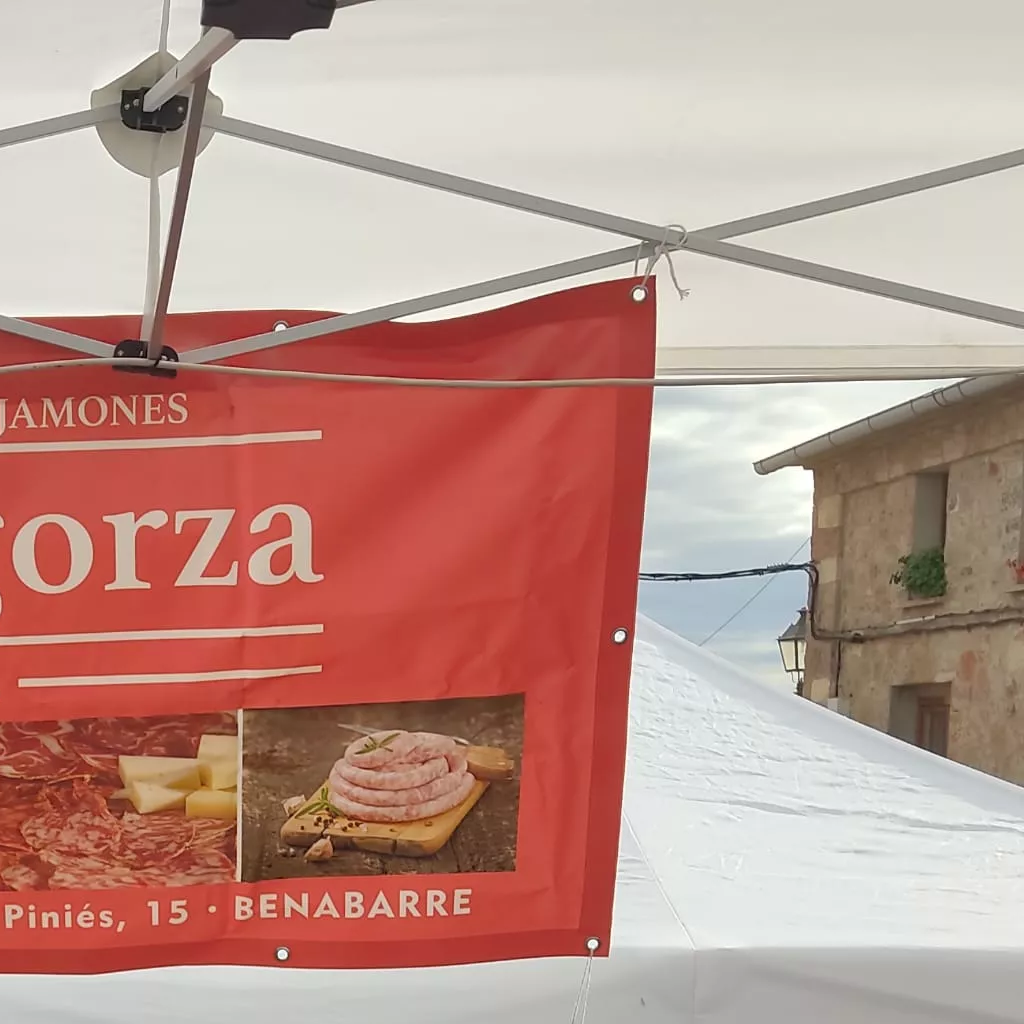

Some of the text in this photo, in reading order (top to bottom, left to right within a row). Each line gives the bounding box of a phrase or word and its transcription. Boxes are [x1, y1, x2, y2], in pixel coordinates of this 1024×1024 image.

[4, 903, 127, 932] Piniés,
[147, 899, 189, 926] 15
[234, 888, 472, 921] BENABARRE
